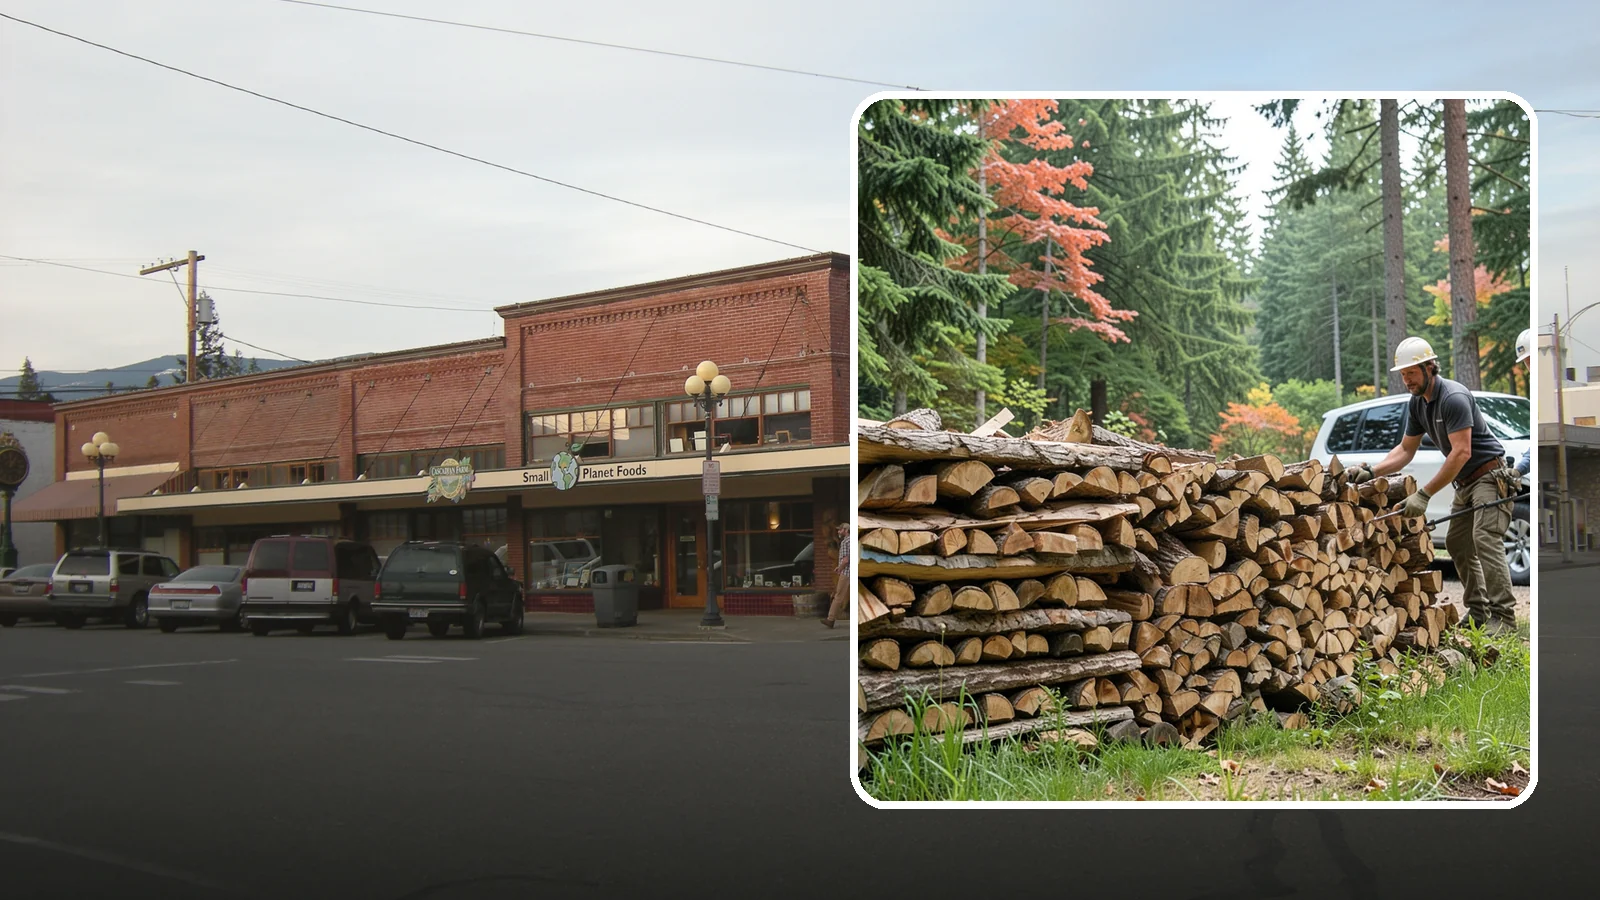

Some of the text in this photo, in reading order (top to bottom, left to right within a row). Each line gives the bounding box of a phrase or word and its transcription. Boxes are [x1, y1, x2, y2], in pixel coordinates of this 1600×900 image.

[523, 464, 647, 483] Small Planet Foods
